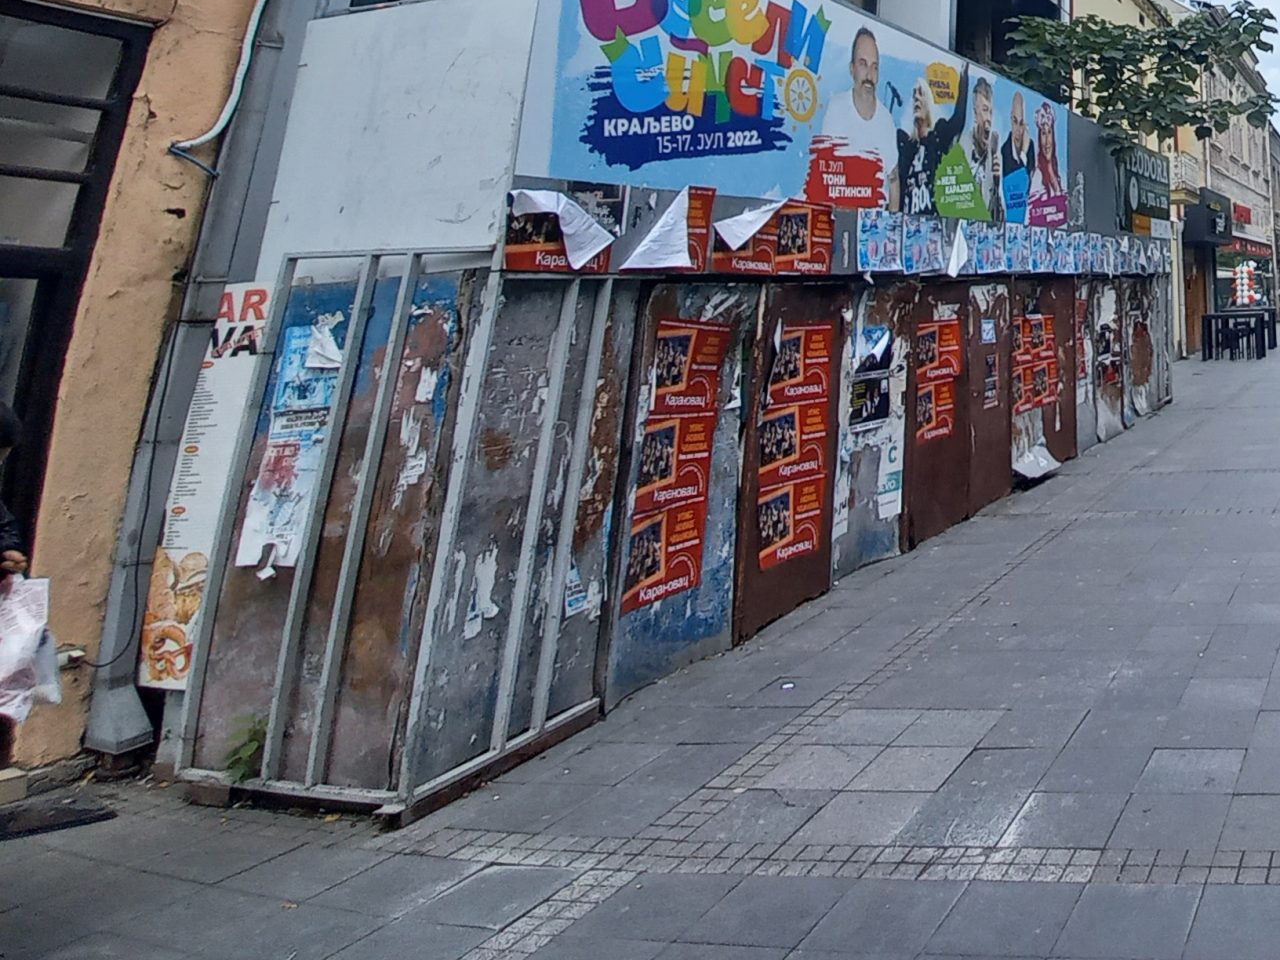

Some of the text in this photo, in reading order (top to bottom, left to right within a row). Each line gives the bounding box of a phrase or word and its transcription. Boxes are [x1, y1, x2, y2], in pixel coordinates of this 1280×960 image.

[603, 114, 695, 137] КРАЉЕВО
[657, 130, 762, 153] 15-17. ЈУЛ 2022.
[822, 173, 846, 185] ТОНИ
[828, 186, 872, 199] ЦЕТИНСКИ
[732, 257, 772, 272] Карановац
[665, 393, 706, 408] Карановац
[653, 485, 698, 503] Карановац
[639, 575, 690, 602] Карановац
